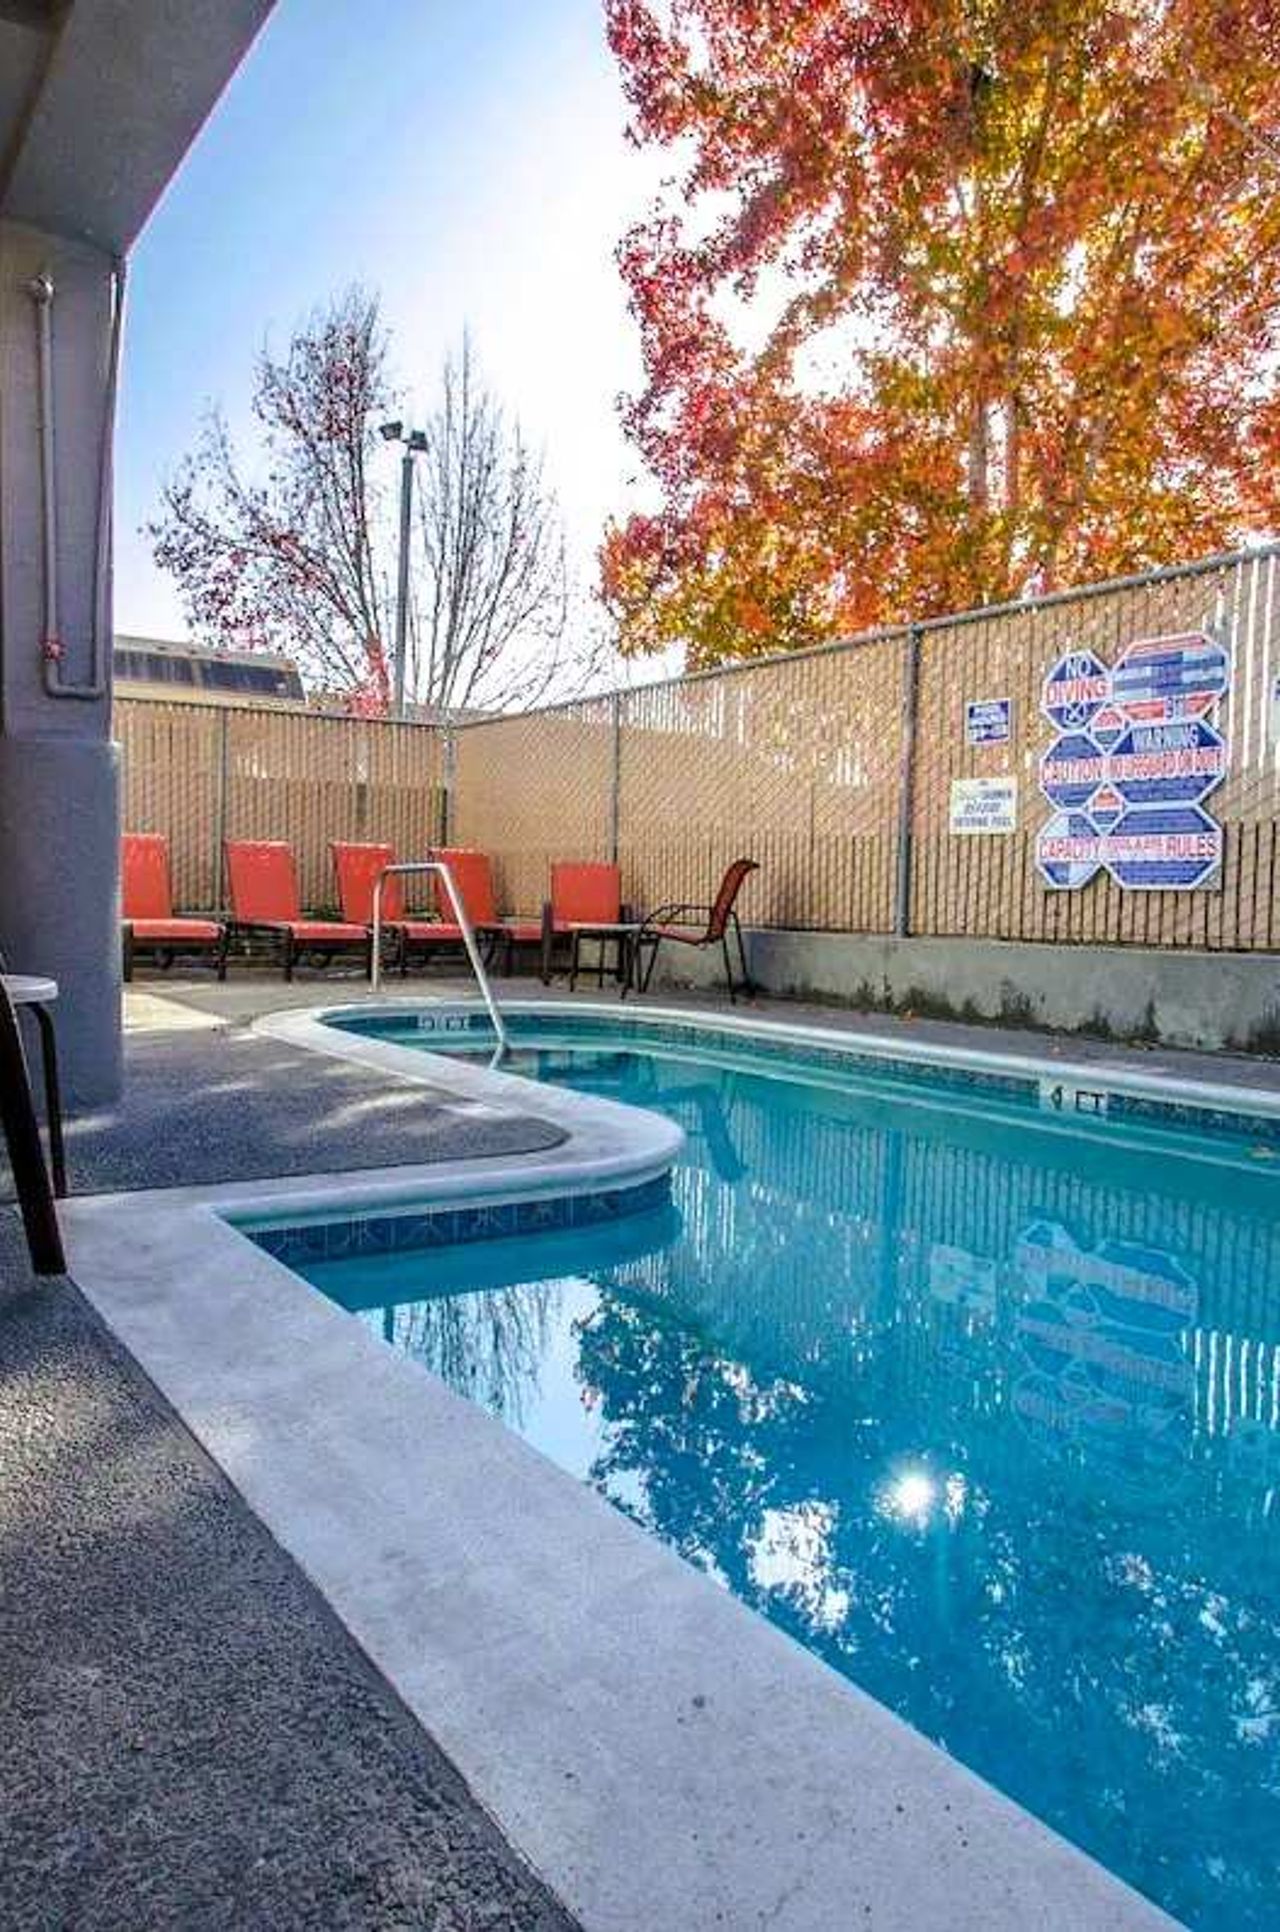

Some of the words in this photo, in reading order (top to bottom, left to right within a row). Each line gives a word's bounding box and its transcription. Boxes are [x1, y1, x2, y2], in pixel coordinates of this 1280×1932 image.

[1065, 657, 1091, 677] NO
[1047, 680, 1106, 705] DIVING
[1041, 837, 1098, 859] CAPACITY
[1165, 835, 1216, 857] RULES
[1076, 1091, 1105, 1111] FT
